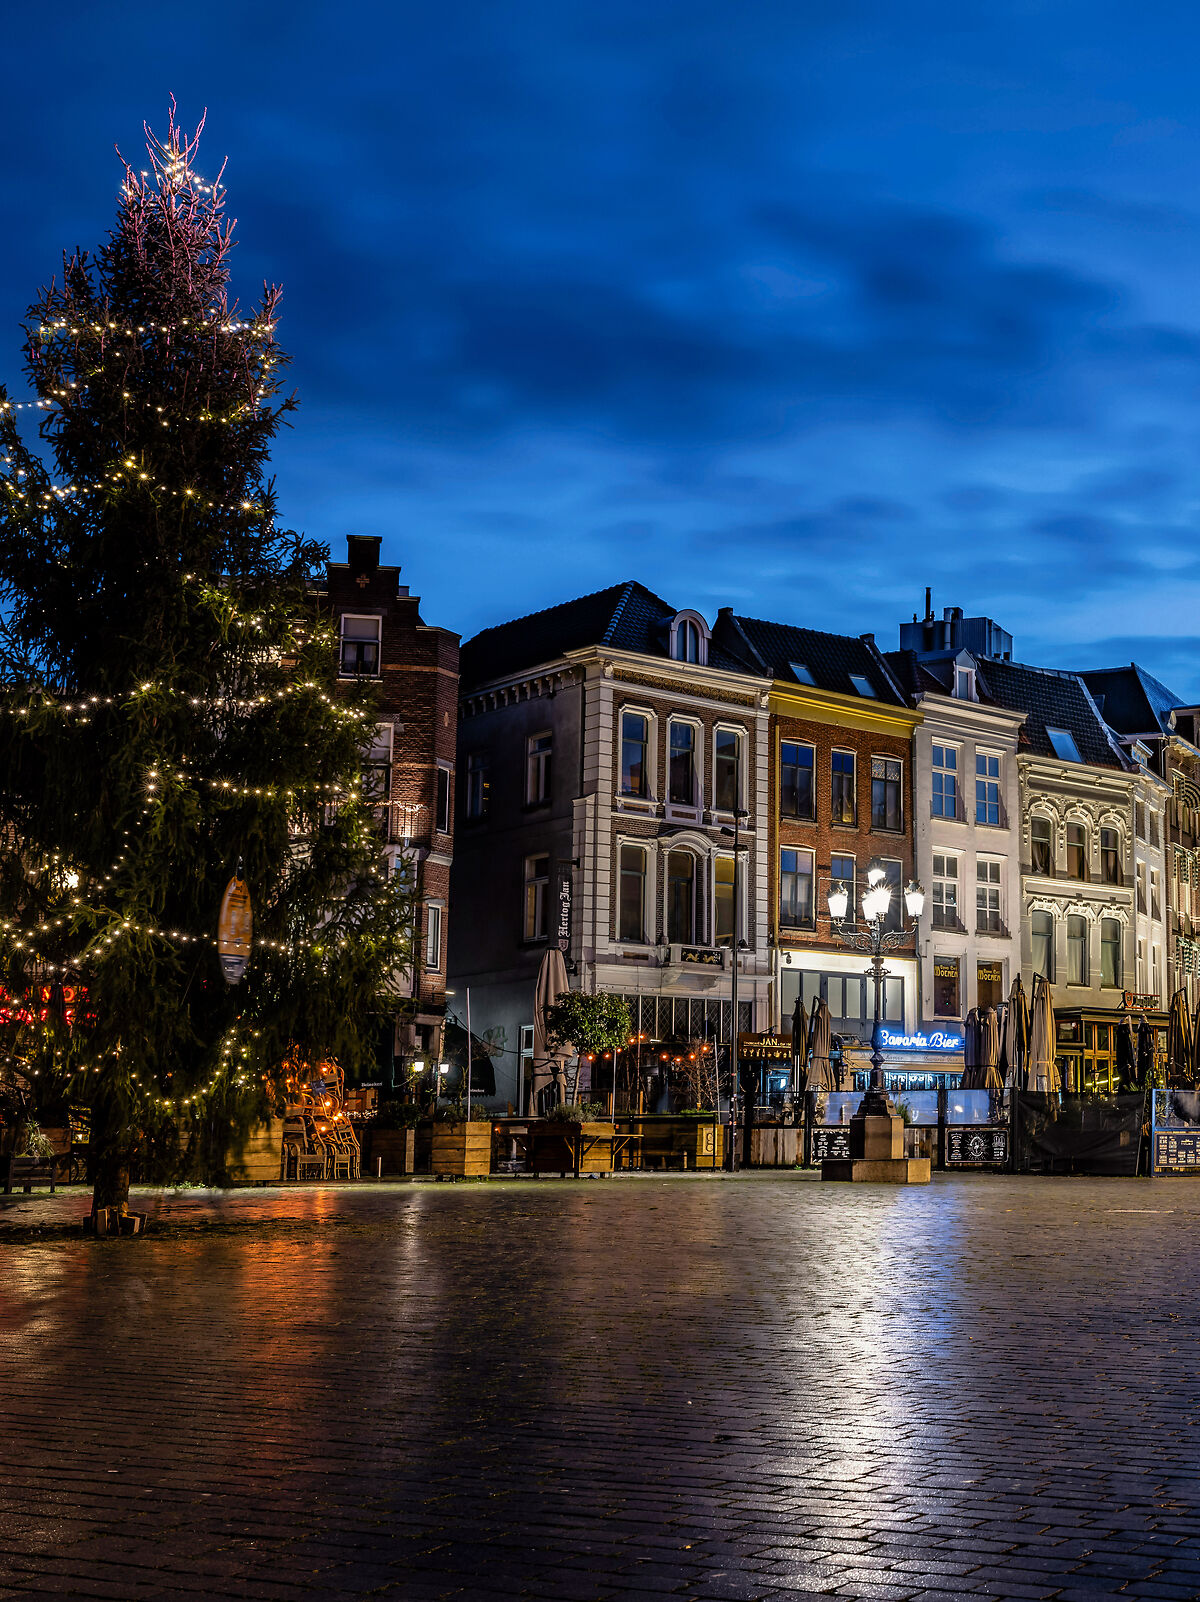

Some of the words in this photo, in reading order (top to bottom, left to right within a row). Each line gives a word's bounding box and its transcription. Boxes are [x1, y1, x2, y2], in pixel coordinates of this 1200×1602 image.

[559, 881, 571, 901] Jan
[558, 901, 571, 938] Hertog
[880, 1030, 928, 1047] Bavaria
[928, 1032, 960, 1048] Bier
